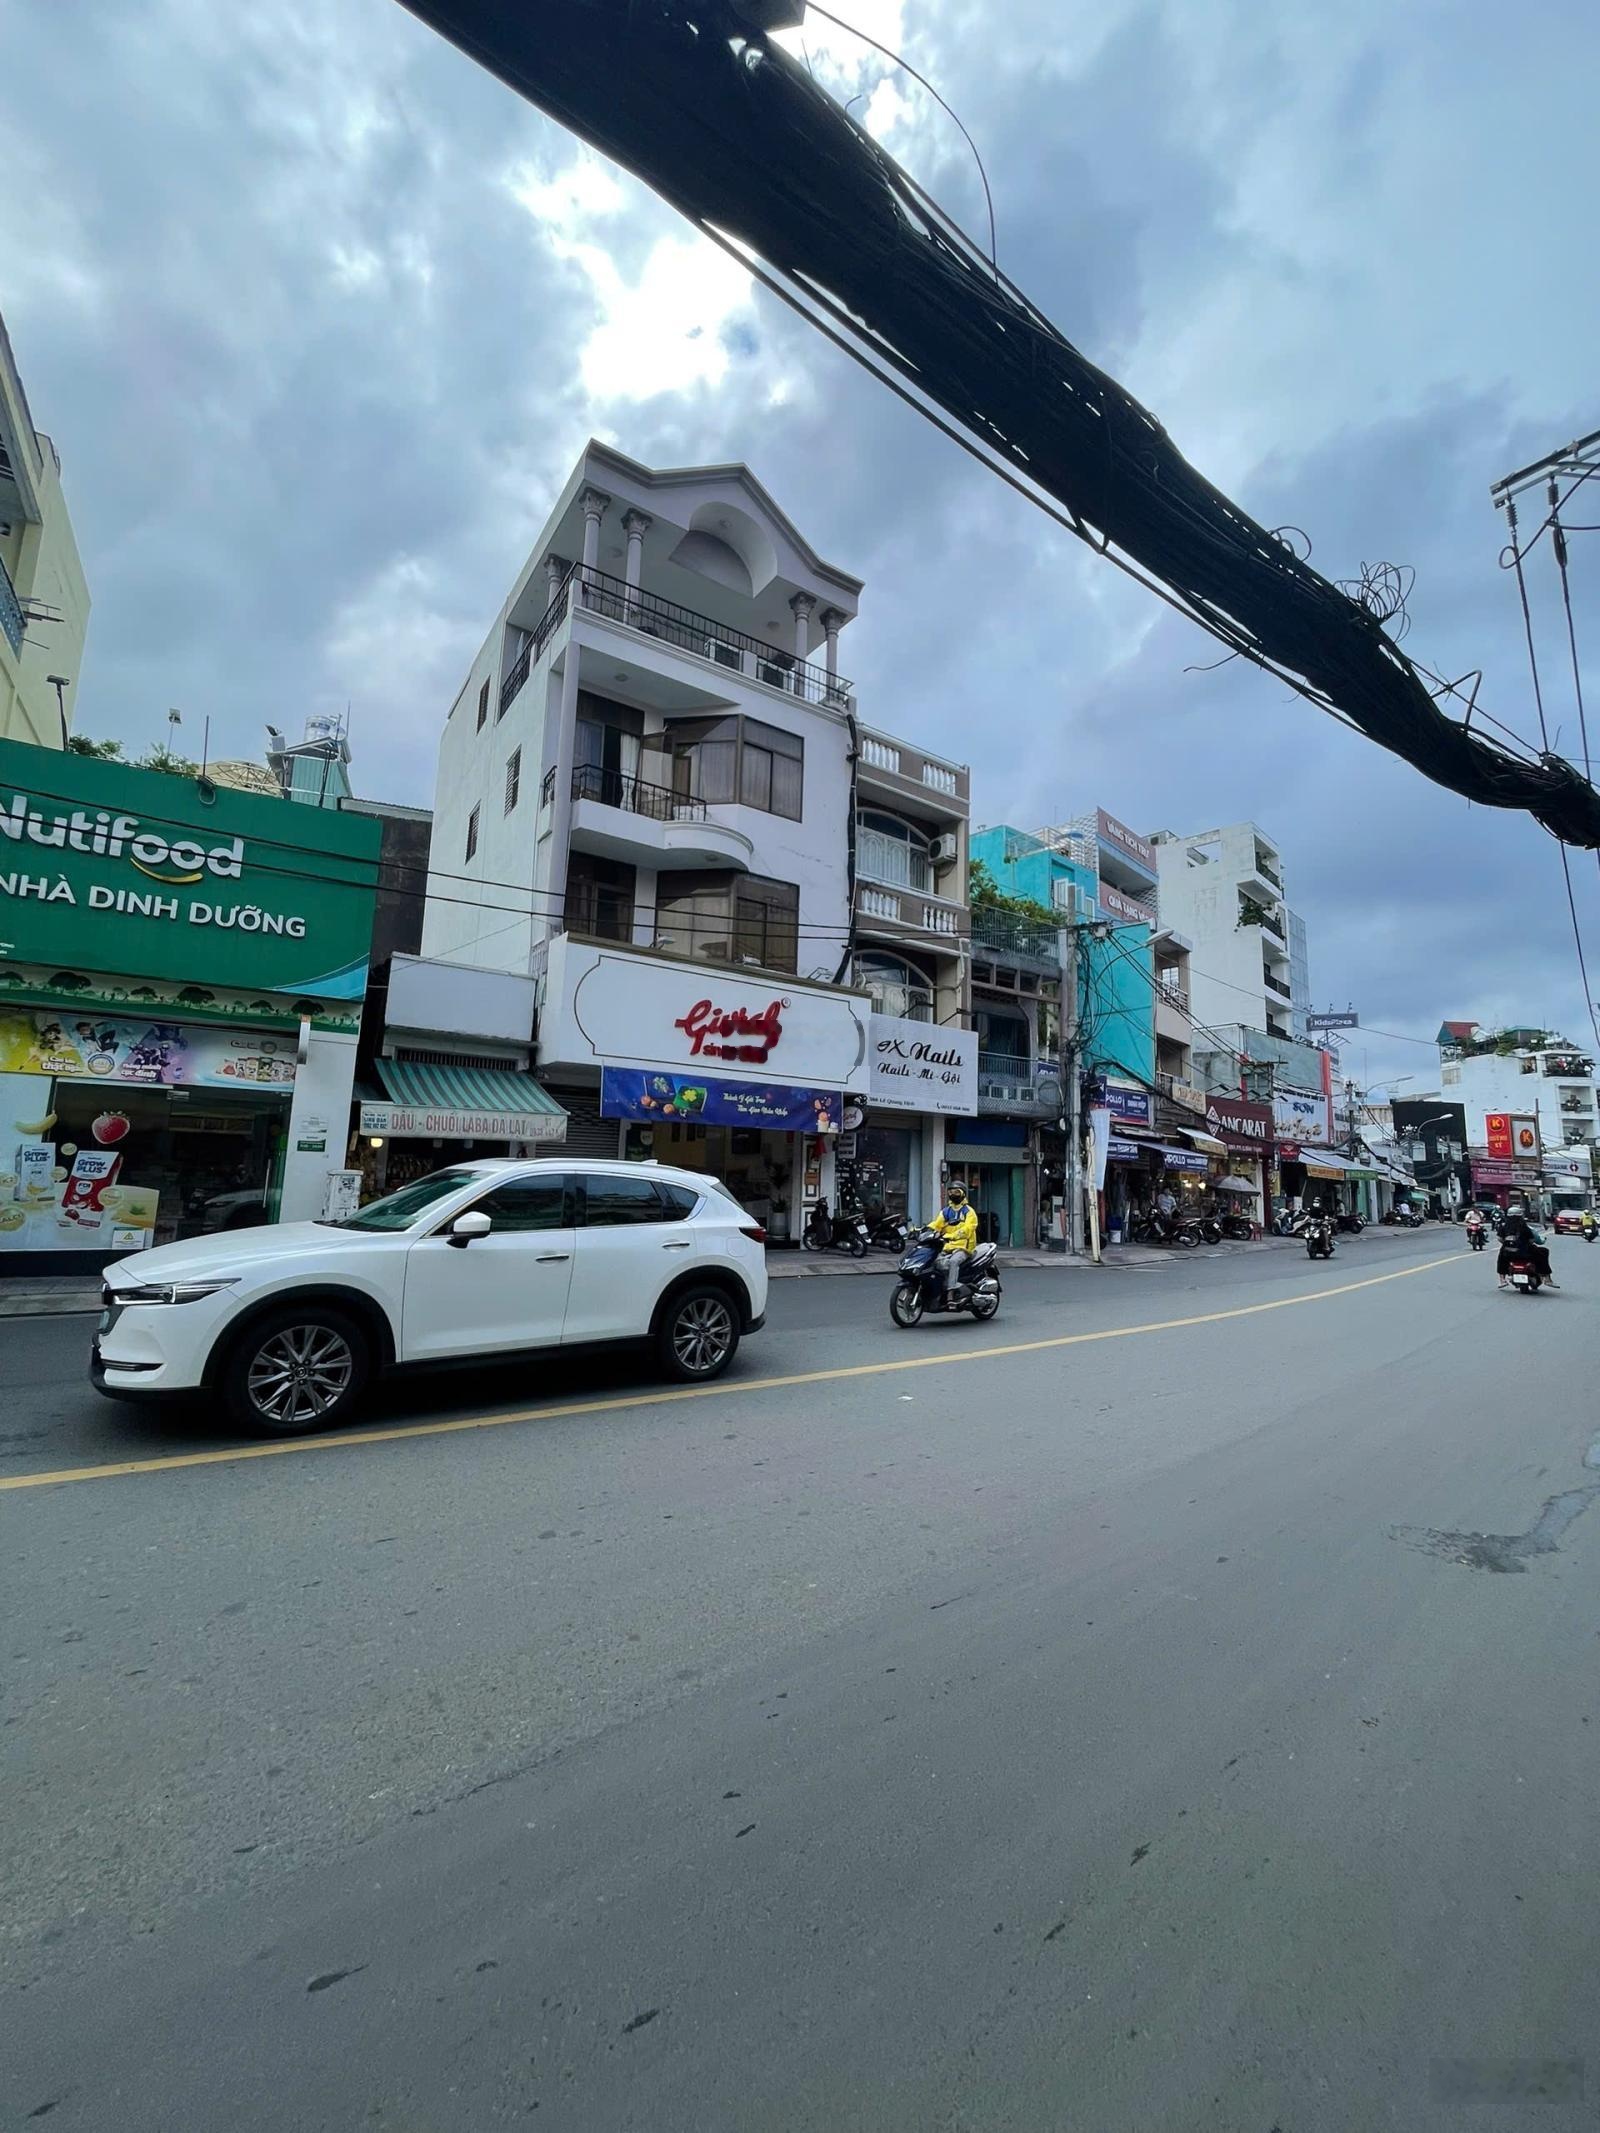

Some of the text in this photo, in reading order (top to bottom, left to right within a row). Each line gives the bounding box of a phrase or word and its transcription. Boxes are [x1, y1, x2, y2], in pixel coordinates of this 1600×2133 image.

[0, 795, 244, 878] Nutifood
[0, 873, 306, 937] NHÀ DINH DƯỠNG
[910, 1042, 963, 1067] Nails
[878, 1063, 909, 1076] Nails
[941, 1071, 960, 1085] Gội
[462, 1116, 488, 1133] LABA
[1220, 1115, 1267, 1138] ANCARAT
[77, 1159, 106, 1168] Grow
